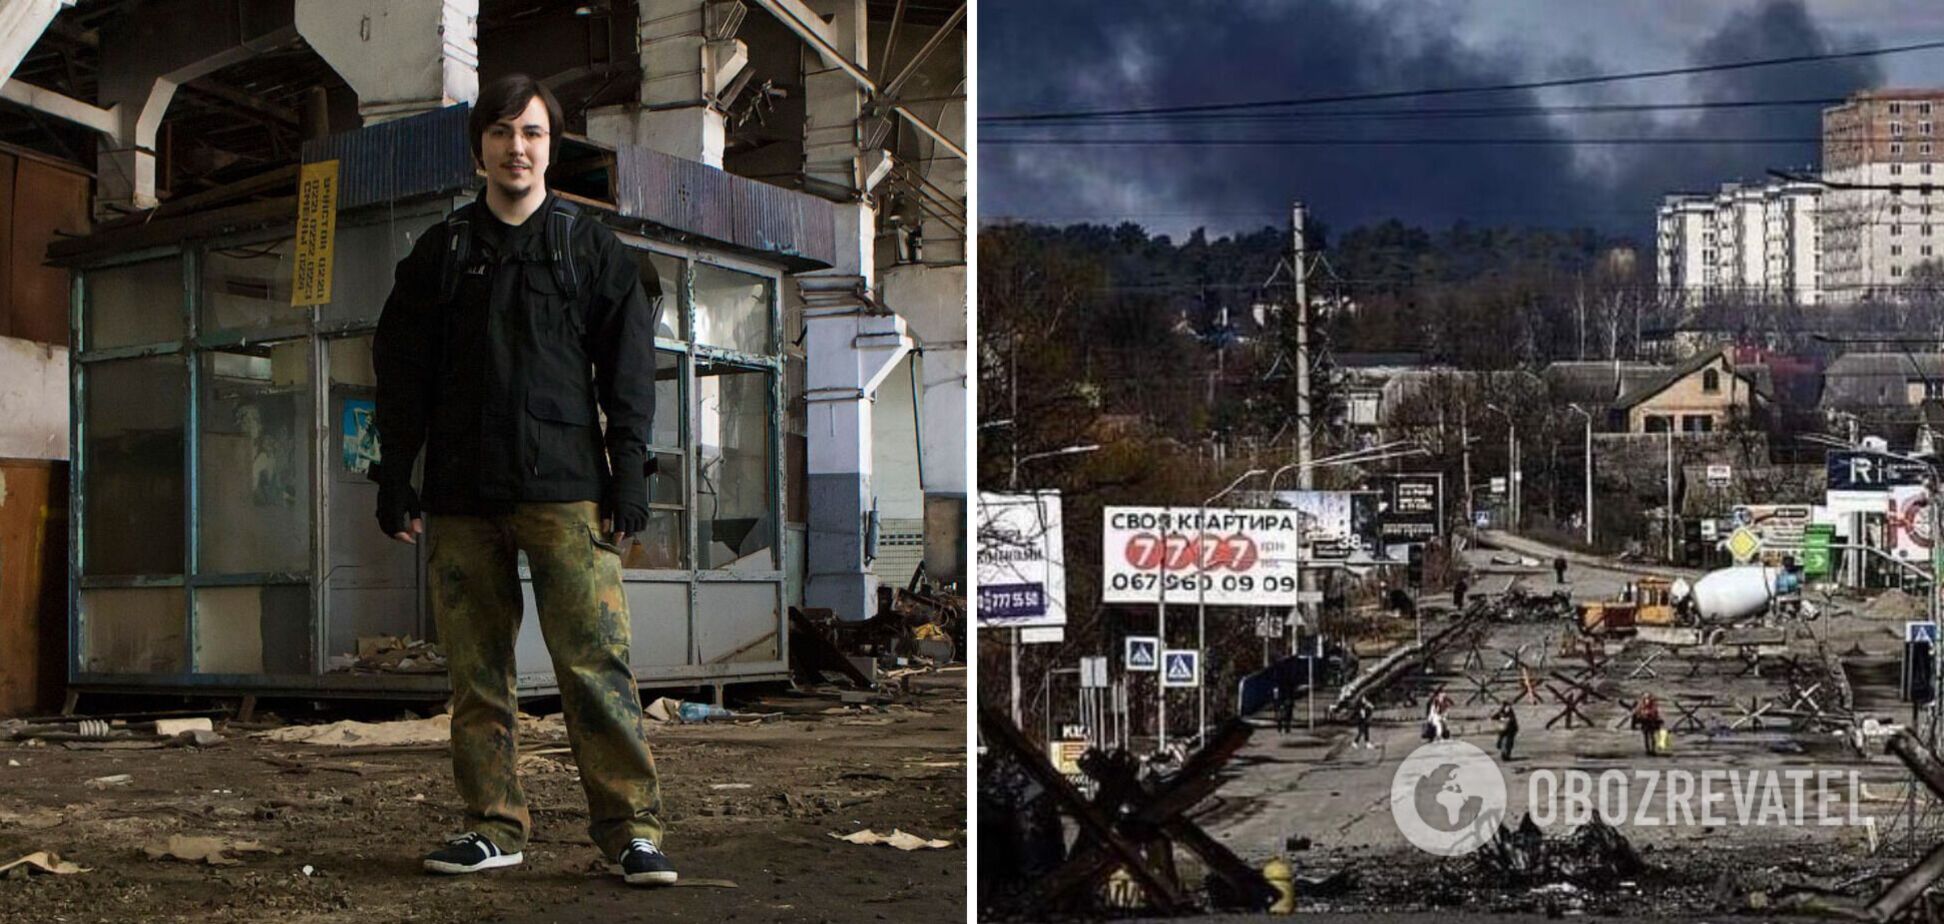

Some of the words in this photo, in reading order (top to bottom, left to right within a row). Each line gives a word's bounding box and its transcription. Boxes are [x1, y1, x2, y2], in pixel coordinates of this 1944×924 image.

[1111, 512, 1171, 531] СВОЯ
[1112, 573, 1158, 591] 067
[1222, 575, 1254, 592] 09
[1263, 576, 1295, 592] 09
[992, 593, 1011, 608] 777
